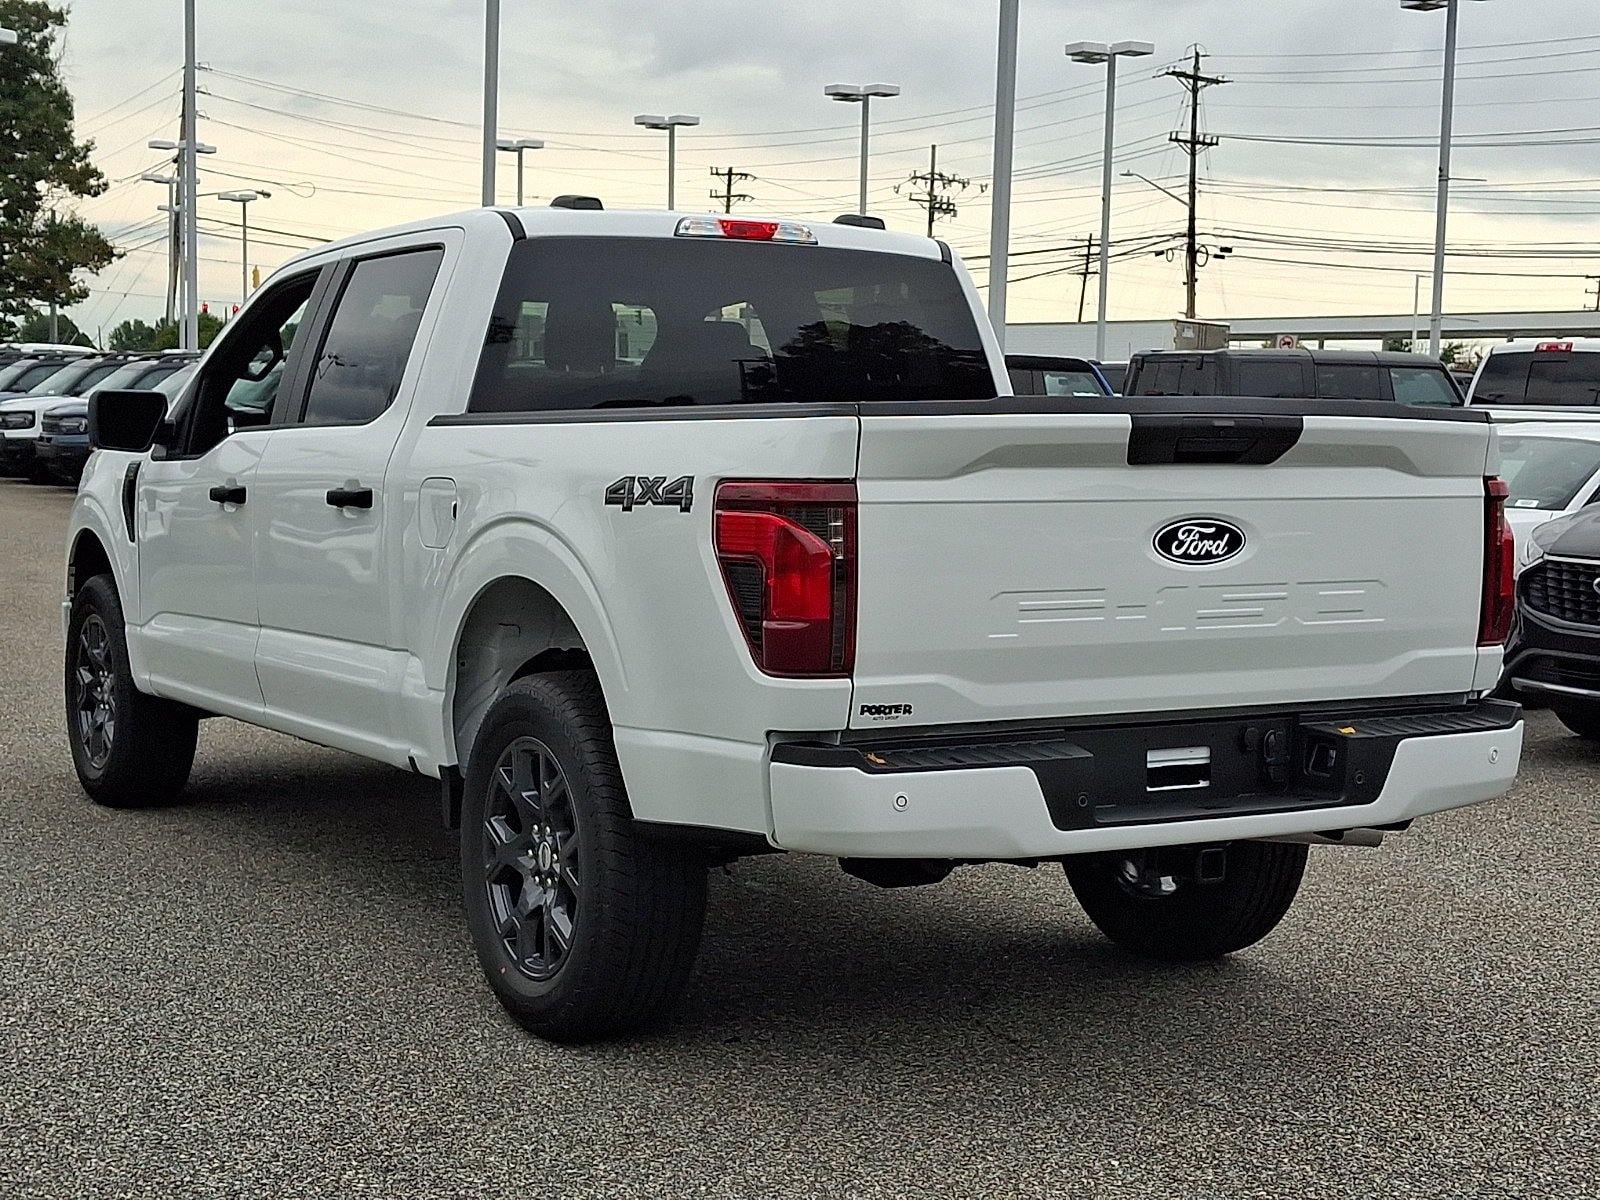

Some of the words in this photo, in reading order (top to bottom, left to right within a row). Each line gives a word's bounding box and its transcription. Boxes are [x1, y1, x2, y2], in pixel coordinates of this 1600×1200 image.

[1171, 525, 1228, 556] Ford
[988, 579, 1388, 639] F-150
[860, 704, 913, 716] PORTER
